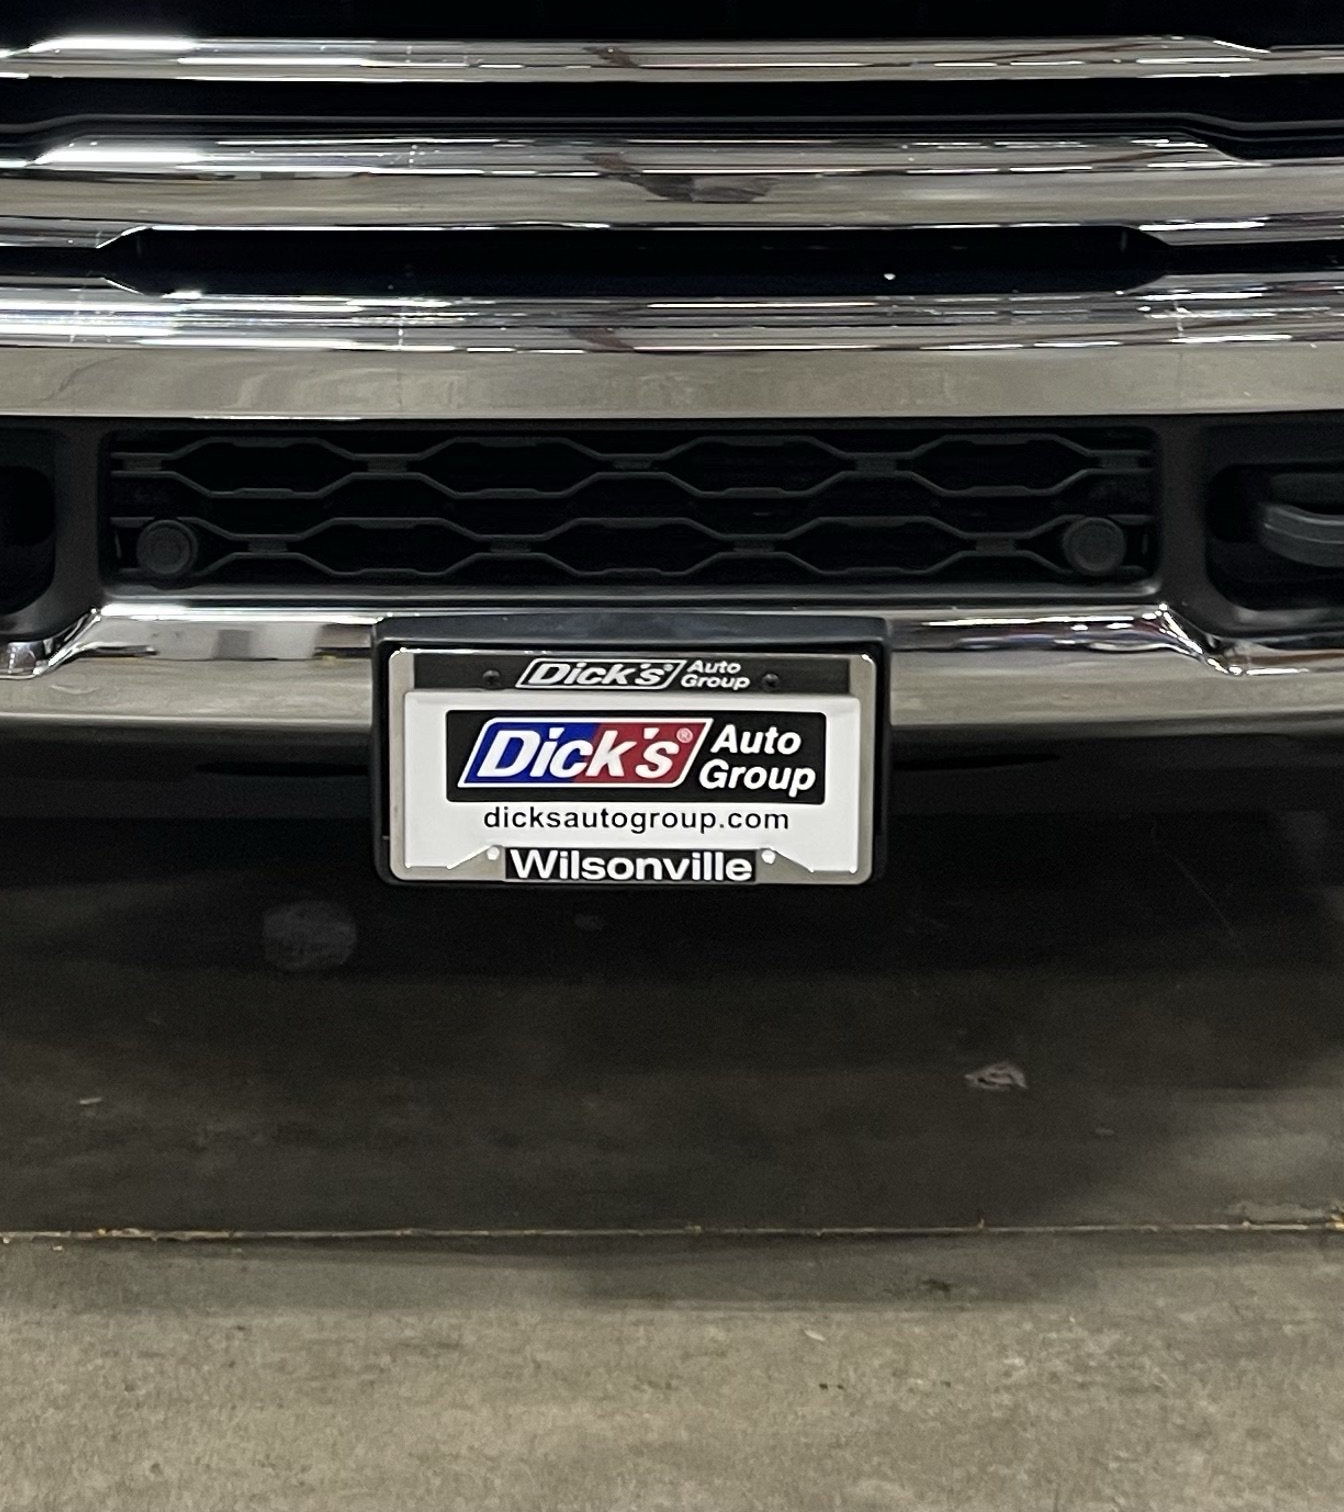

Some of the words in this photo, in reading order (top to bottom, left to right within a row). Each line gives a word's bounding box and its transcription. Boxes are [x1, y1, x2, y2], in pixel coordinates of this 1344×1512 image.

[528, 662, 665, 686] Dick's
[686, 659, 742, 674] Auto
[680, 673, 751, 691] Group
[476, 727, 681, 779] Dick's
[710, 724, 803, 756] Auto
[698, 758, 817, 798] Group
[482, 806, 790, 834] dicksautogroup.com
[509, 848, 754, 882] Wilsonville
